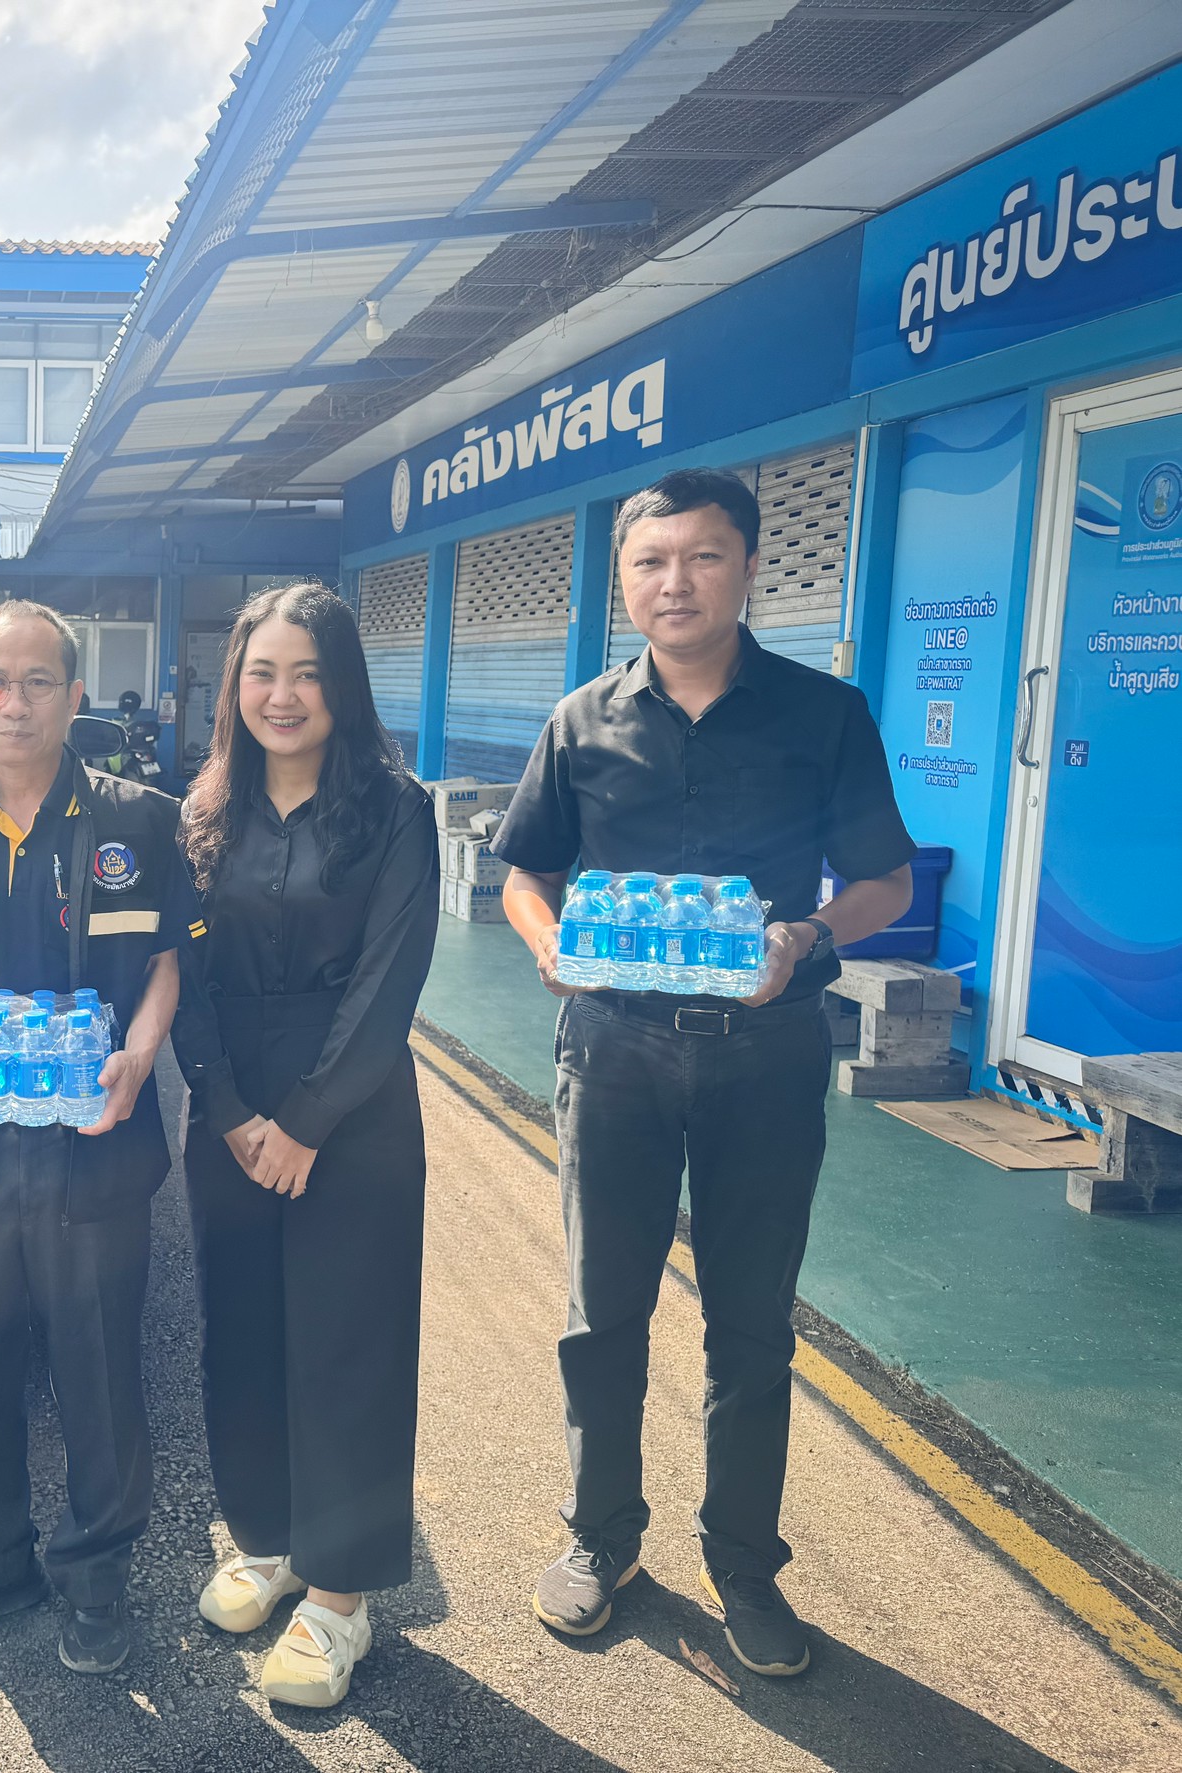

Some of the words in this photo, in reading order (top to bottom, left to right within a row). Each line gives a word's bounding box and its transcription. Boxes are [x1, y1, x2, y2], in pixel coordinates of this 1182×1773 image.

[422, 357, 666, 506] คลังพัสดุ
[905, 592, 997, 620] ช่องทางการติดต่อ
[924, 627, 968, 649] LINE@
[1088, 632, 1182, 652] บริการและคว
[918, 656, 971, 670] กปภ.สาขาตราด
[917, 676, 963, 690] ID:PWATRAT
[1109, 660, 1179, 695] น้ำสูญเสีย
[1070, 743, 1084, 751] Pull
[910, 755, 977, 776] การประปาส่วนภูมิภาค
[1070, 753, 1082, 766] ดึง
[926, 774, 959, 787] สาขาตราด
[449, 791, 478, 801] ASAHI
